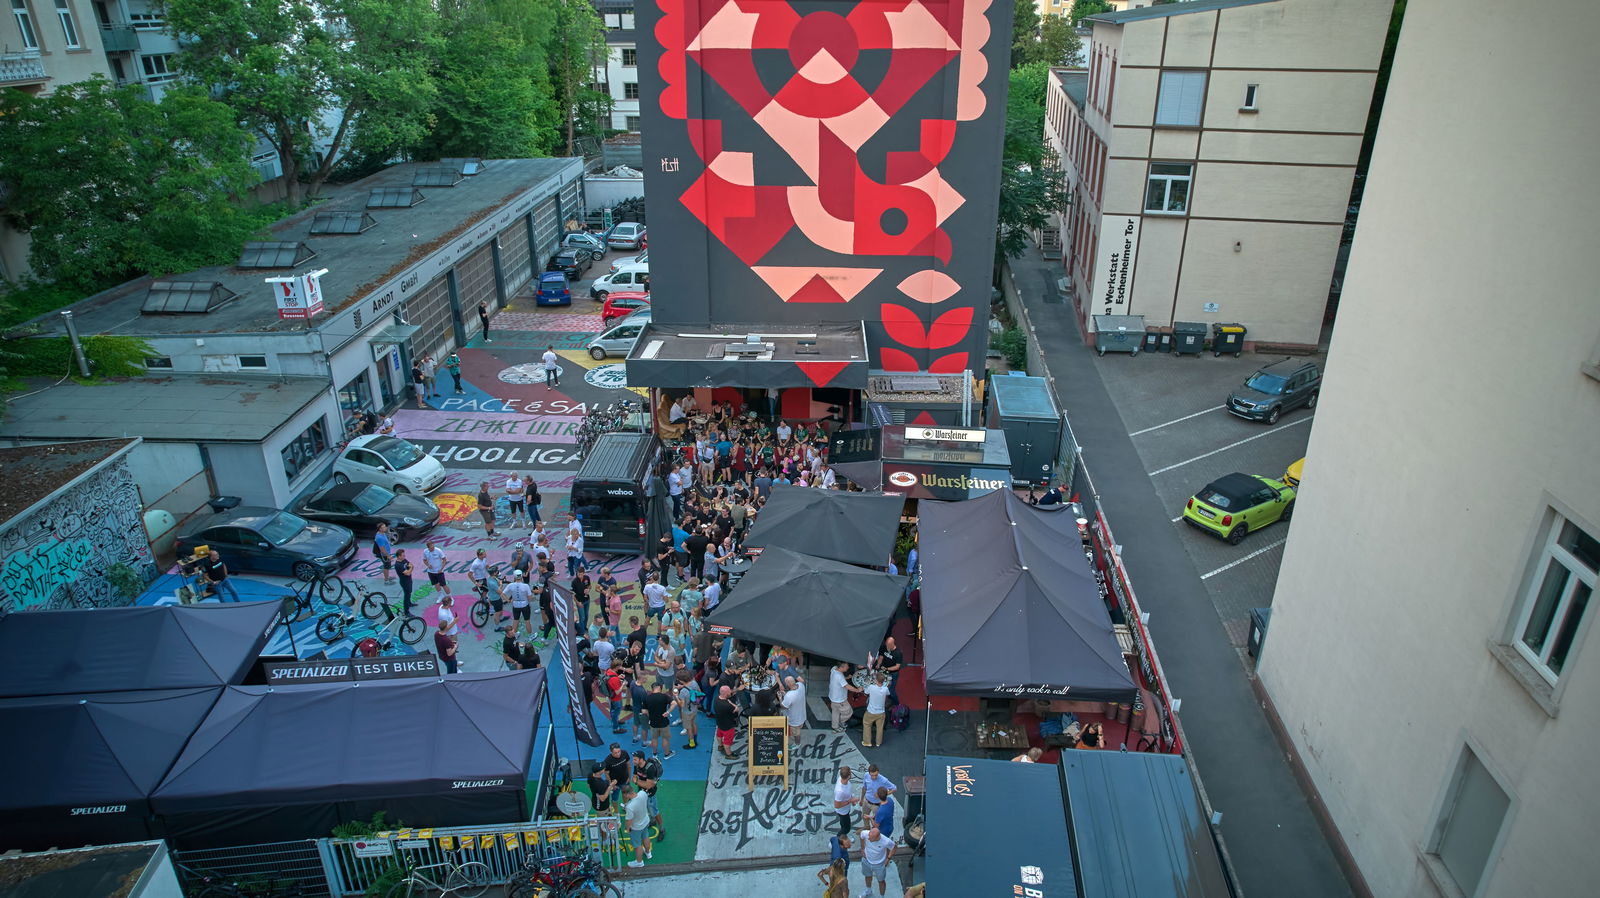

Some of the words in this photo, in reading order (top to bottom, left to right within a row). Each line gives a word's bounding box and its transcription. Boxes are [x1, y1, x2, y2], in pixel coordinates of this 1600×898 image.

[1116, 239, 1132, 305] Eschenheimer
[1125, 219, 1134, 237] Tor
[1105, 253, 1119, 305] Werkstatt
[440, 398, 521, 413] PACE
[526, 421, 581, 436] ULTR
[935, 429, 968, 440] Warsteiner
[427, 445, 582, 465] HOOLIGA
[271, 665, 348, 680] SPECIALIZED
[355, 663, 389, 675] TEST
[394, 660, 434, 672] BIKES
[1006, 684, 1025, 696] only
[452, 779, 505, 789] SPECIALIZED
[70, 805, 126, 816] SPECIALIZED
